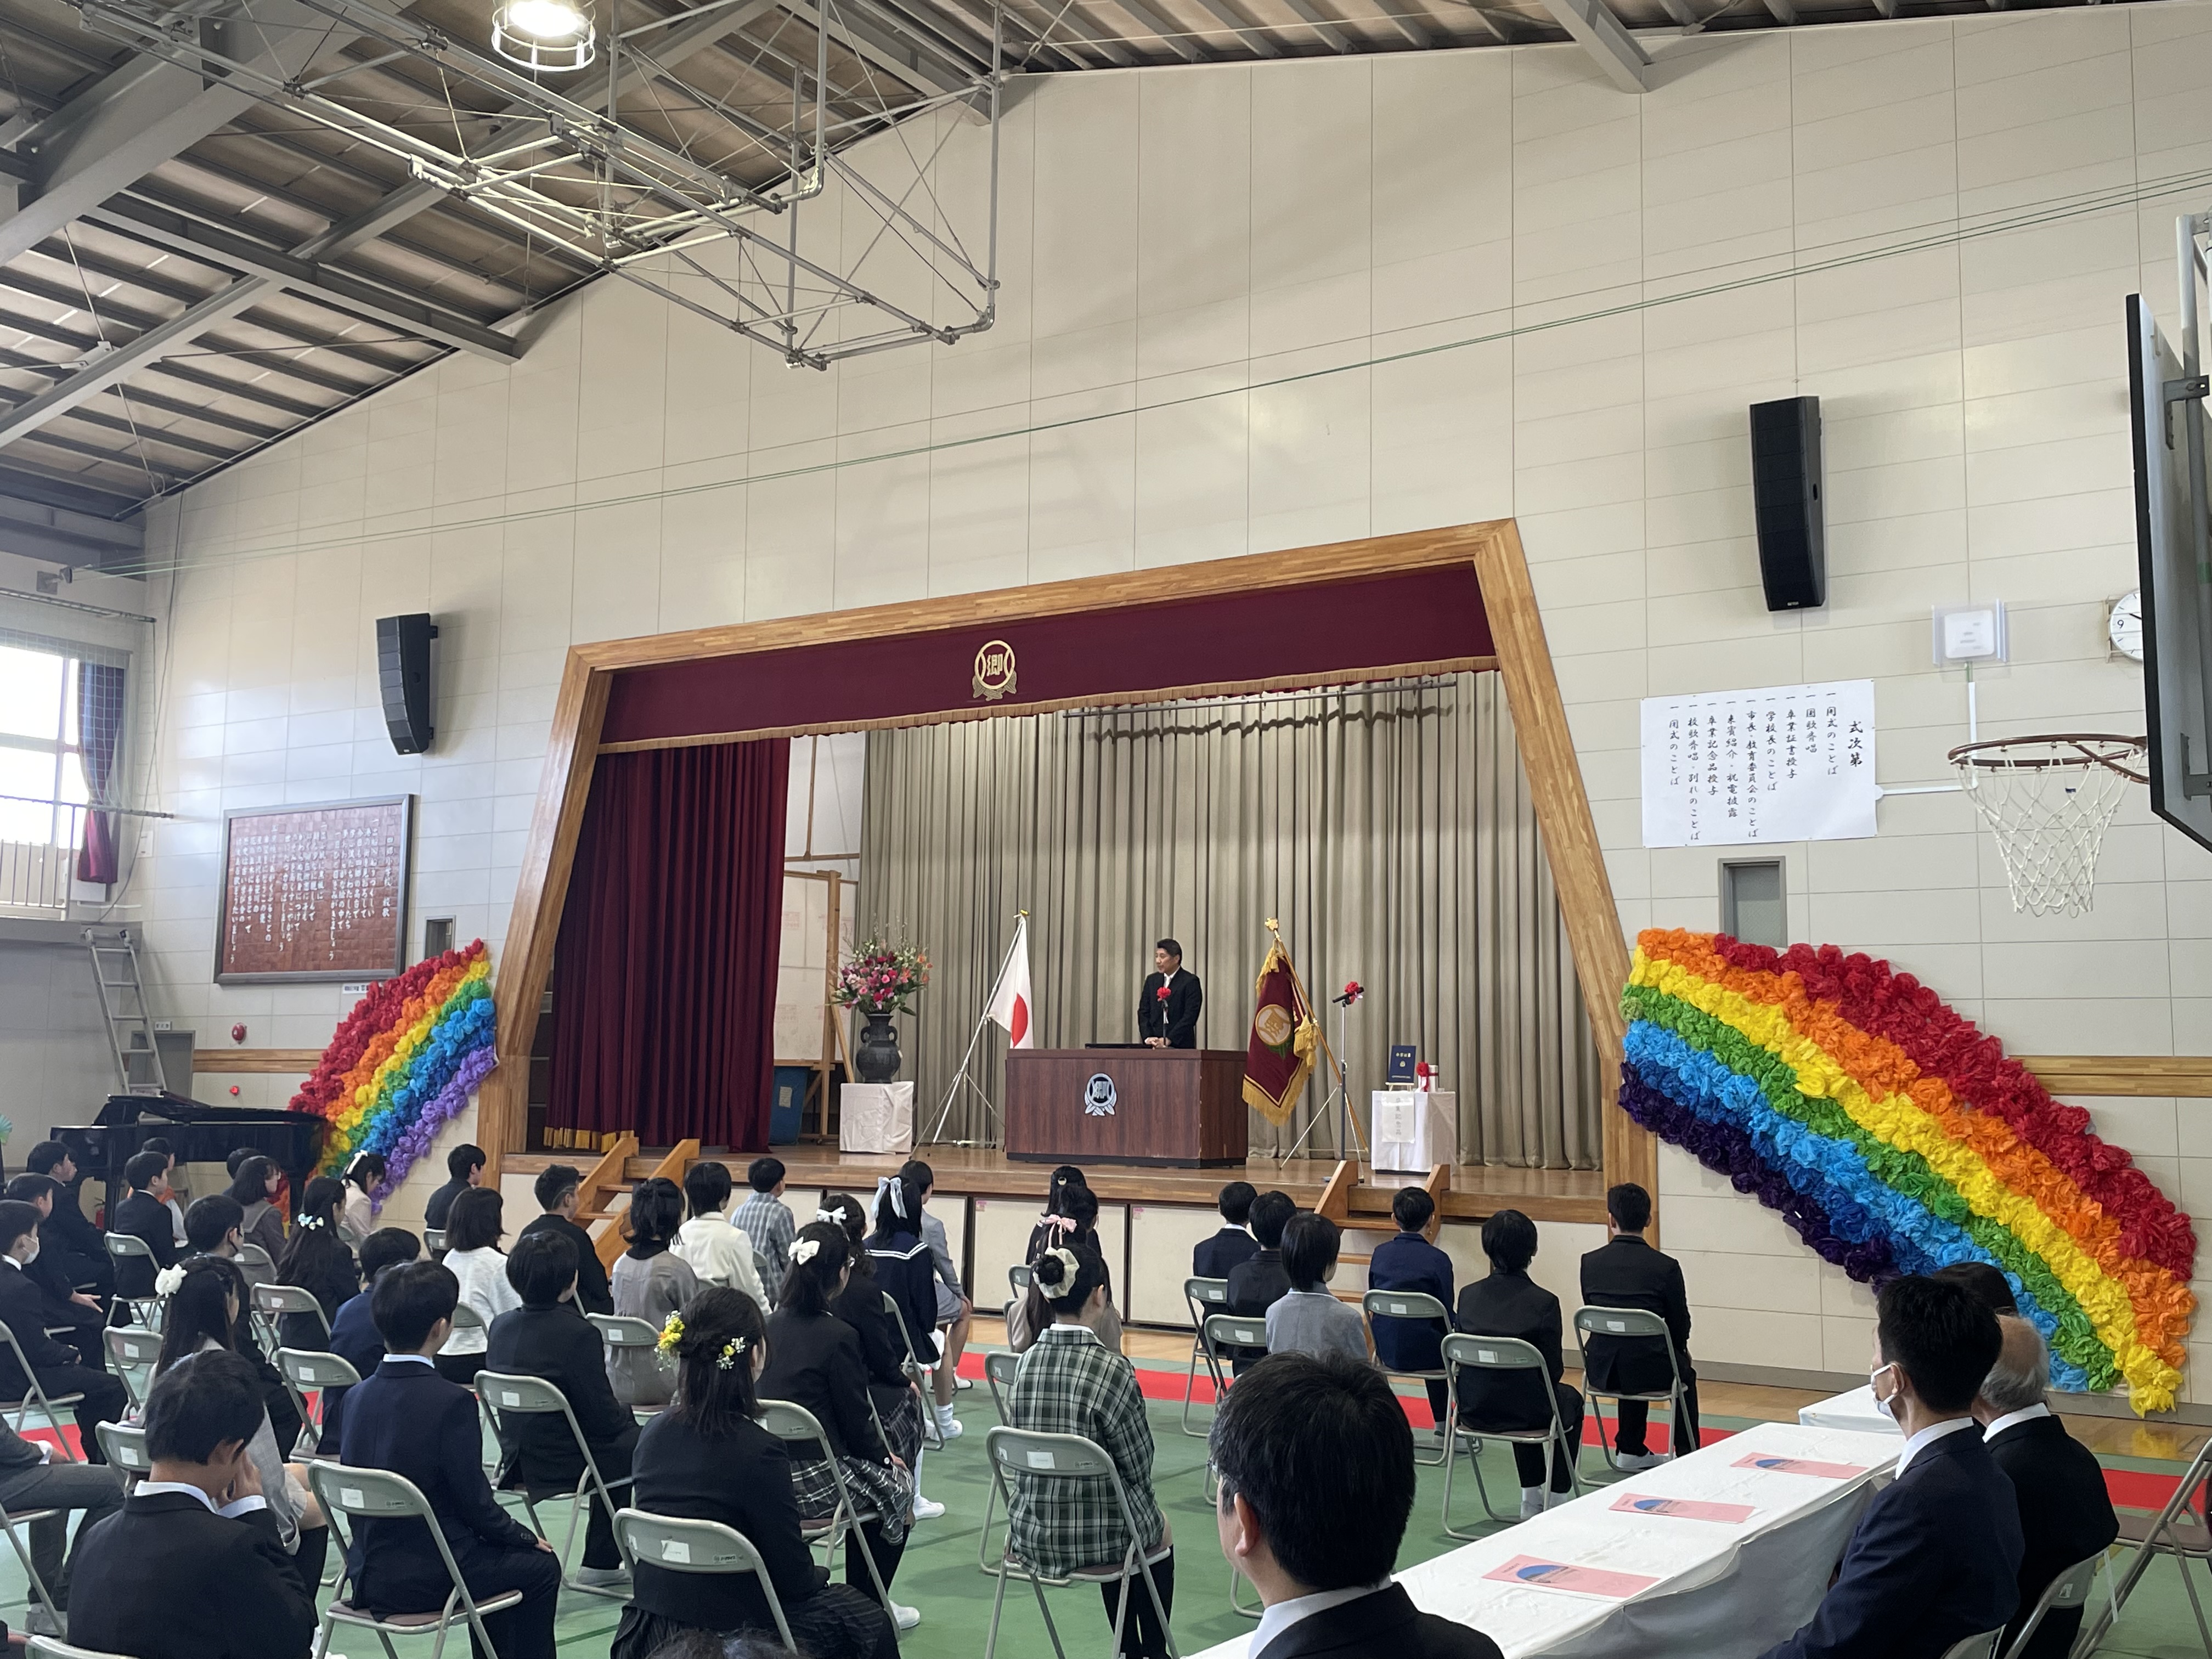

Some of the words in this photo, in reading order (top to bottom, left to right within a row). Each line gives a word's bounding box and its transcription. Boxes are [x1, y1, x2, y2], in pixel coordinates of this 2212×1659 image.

[2117, 619, 2124, 629] 9
[1706, 715, 1718, 795] 卒業記念品授与
[1725, 713, 1739, 818] 来賓紹介・祝電披露
[1765, 711, 1778, 791] 学校長のことば
[1785, 709, 1797, 779] 卒業証書授与
[1805, 708, 1817, 753] 国歌斉唱
[1847, 720, 1864, 768] 式次第
[1687, 716, 1700, 840] 校歌斉唱・別れのことば
[1745, 710, 1758, 838] 市長・教育委員会のことば
